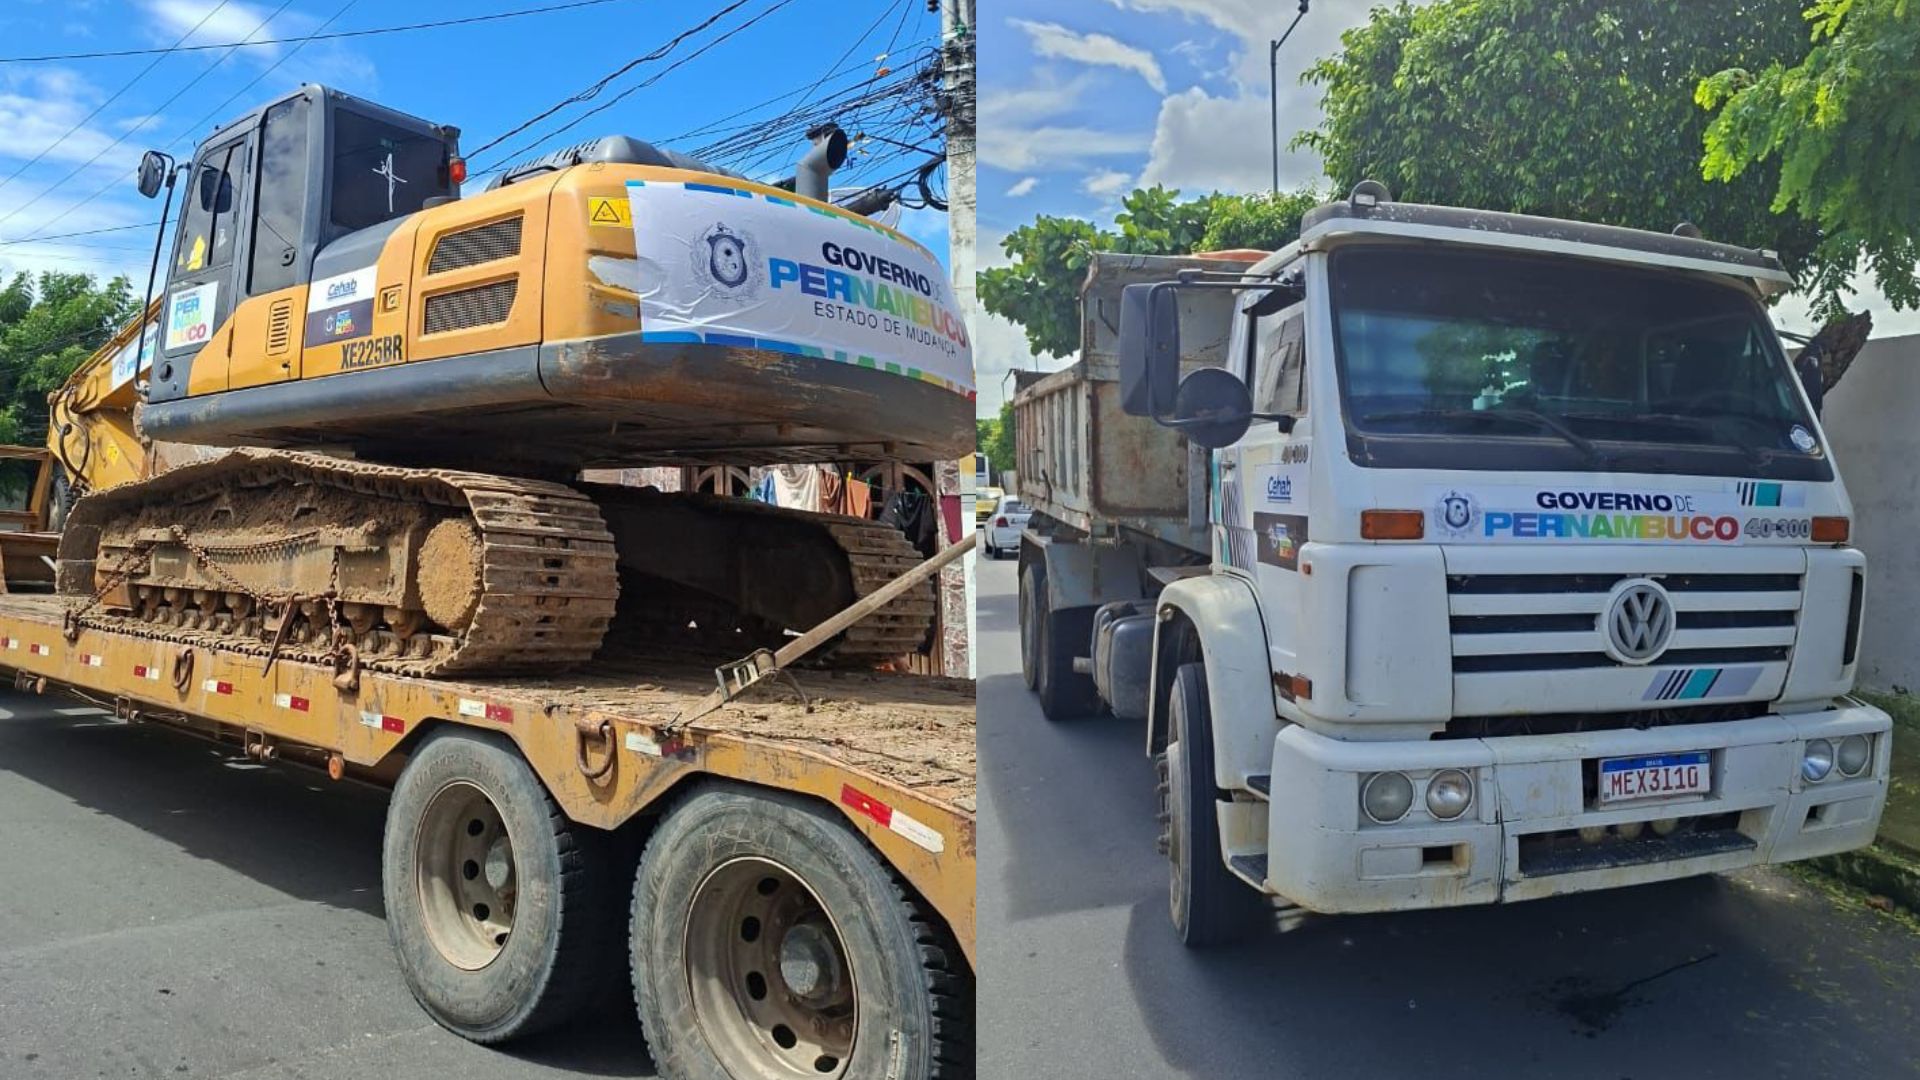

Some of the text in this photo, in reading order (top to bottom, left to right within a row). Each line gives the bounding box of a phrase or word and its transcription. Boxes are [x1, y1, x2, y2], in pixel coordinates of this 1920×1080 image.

[822, 241, 931, 297] GOVERNO
[327, 278, 357, 297] Cehab
[768, 257, 967, 348] PERNAMBUCO
[814, 301, 957, 358] ESTADO DE MUDANÇA
[341, 334, 402, 370] XE225BR
[1267, 475, 1291, 496] Cehab
[1536, 491, 1696, 513] GOVERNO DE
[1484, 511, 1739, 541] PERNAMBUCO
[1743, 517, 1812, 539] 40-300
[1611, 765, 1699, 796] MEX3I10
